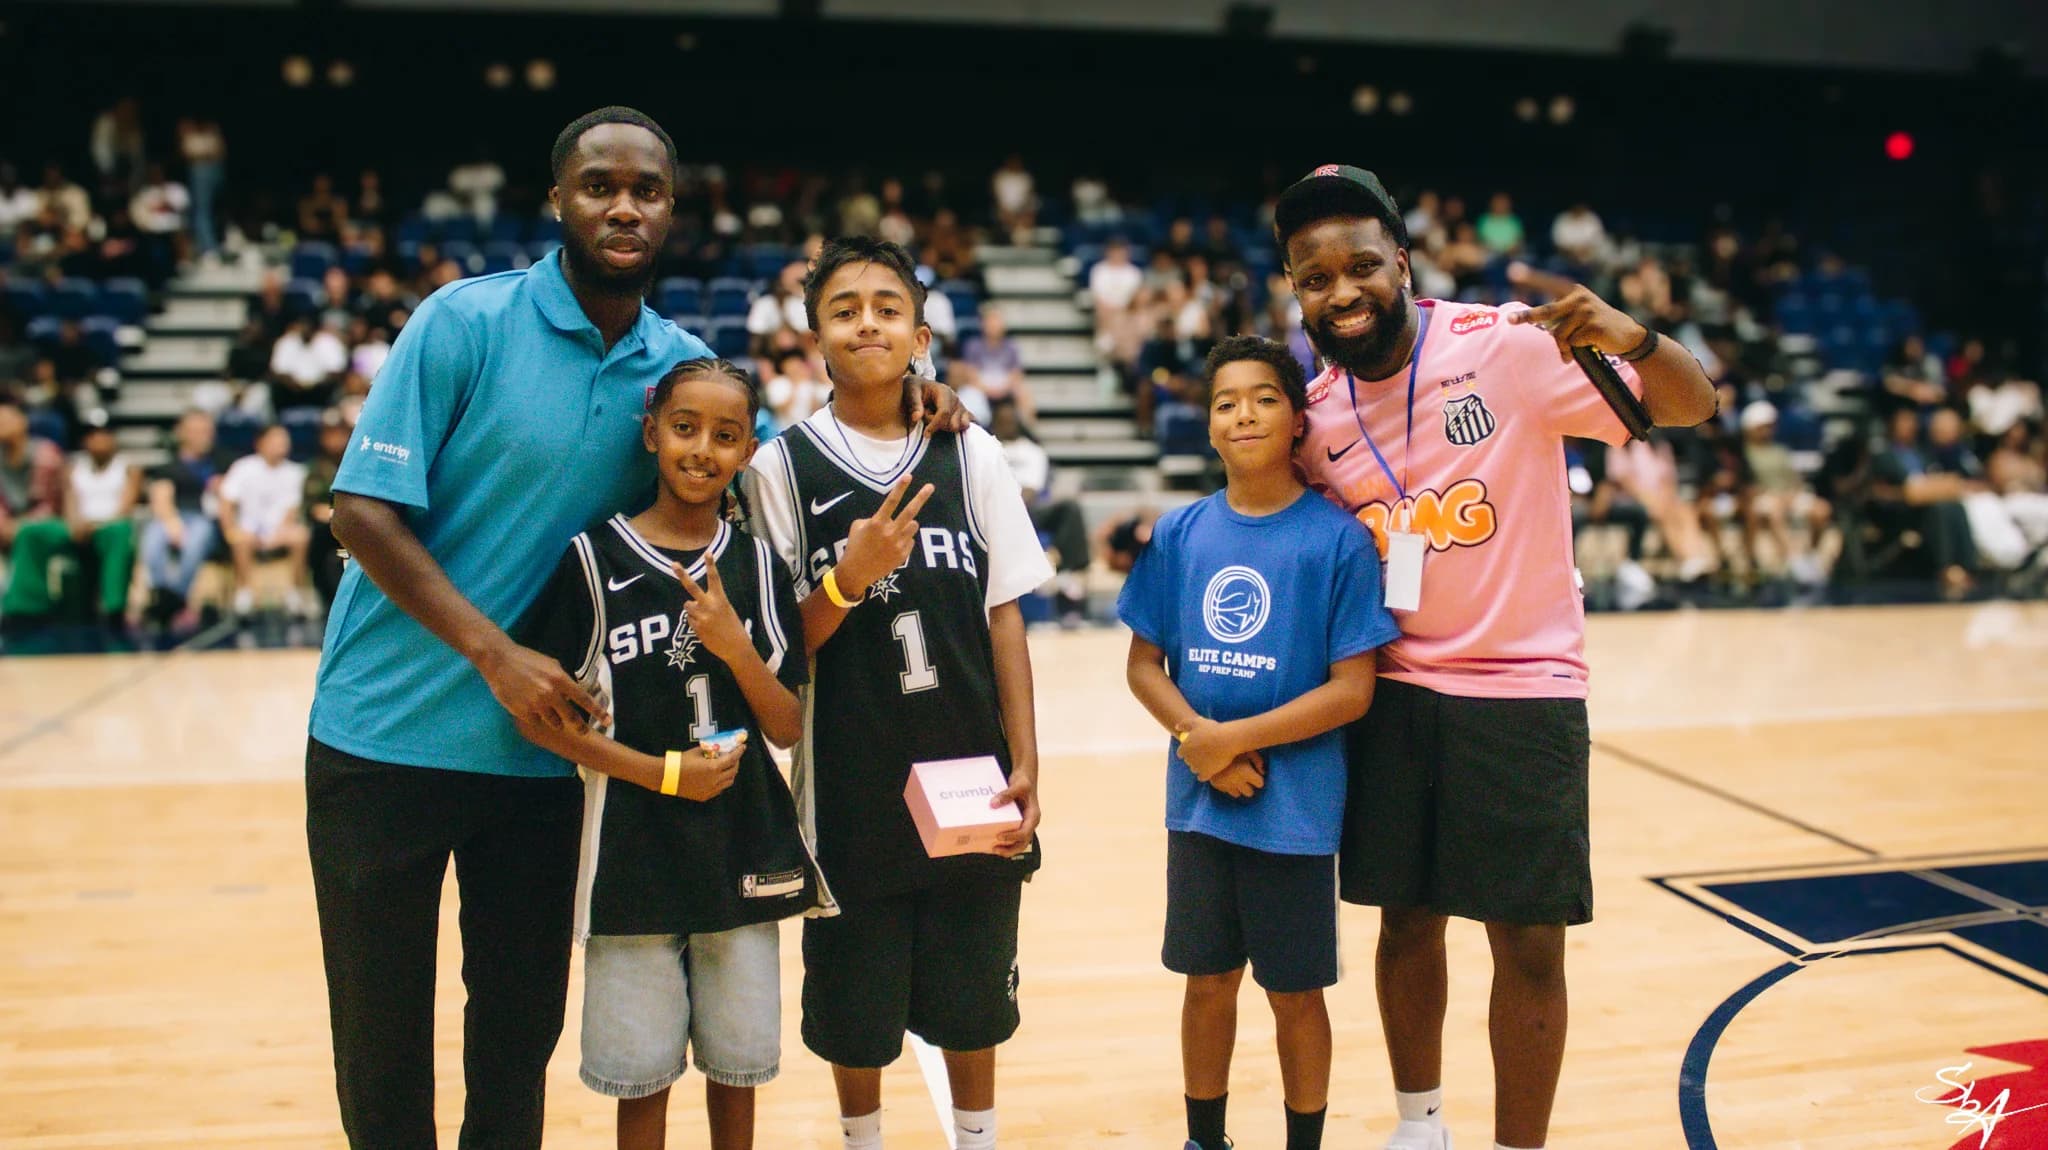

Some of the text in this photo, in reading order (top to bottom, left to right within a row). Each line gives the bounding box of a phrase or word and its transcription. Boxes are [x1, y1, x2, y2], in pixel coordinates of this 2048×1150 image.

[1453, 316, 1494, 331] SEARA
[890, 609, 940, 695] 1
[1188, 648, 1277, 671] ELITE CAMPS
[1232, 668, 1256, 679] CAMP
[685, 673, 719, 742] 1
[939, 785, 997, 800] crumbl
